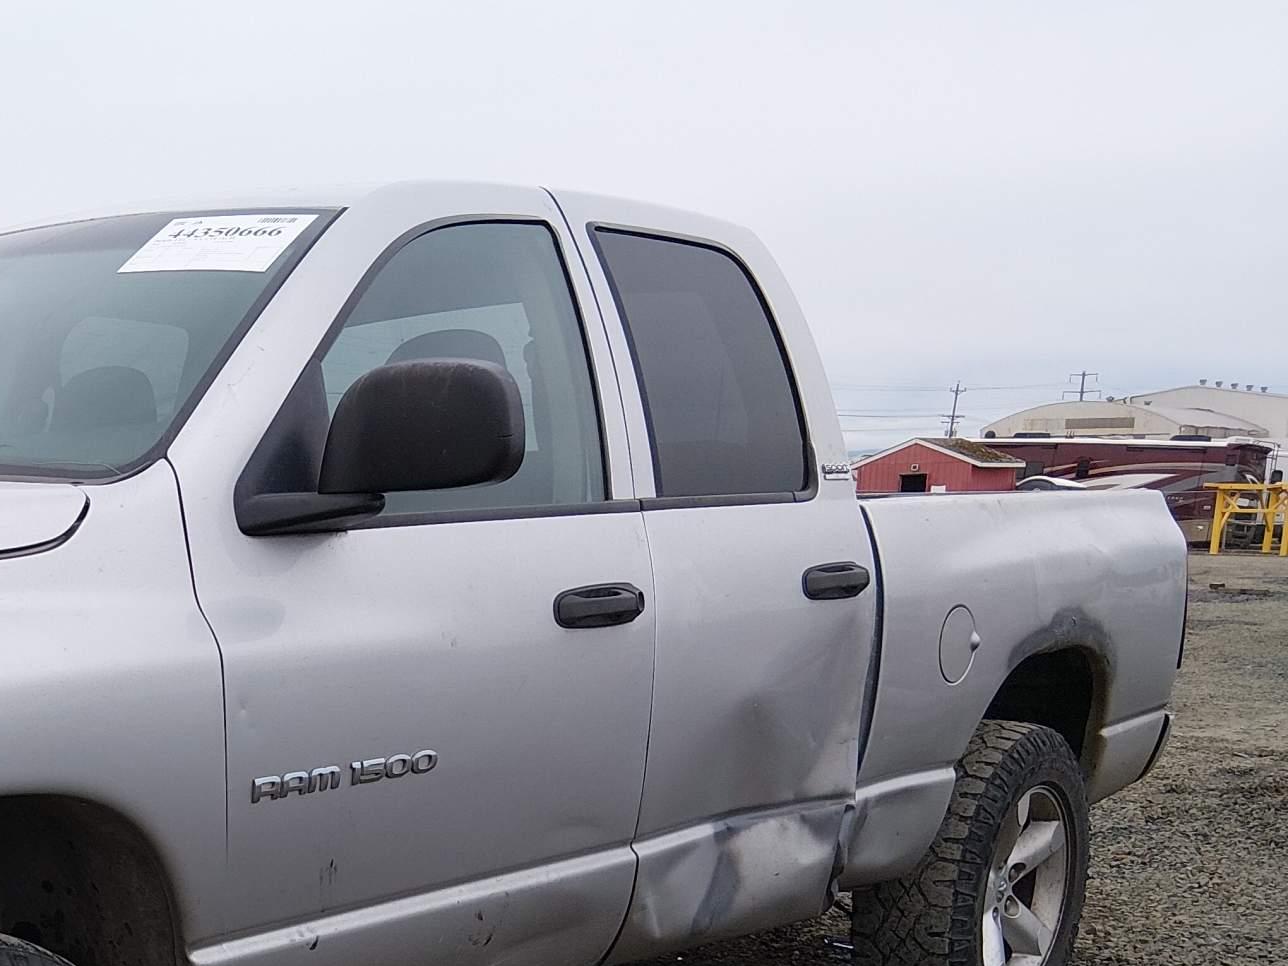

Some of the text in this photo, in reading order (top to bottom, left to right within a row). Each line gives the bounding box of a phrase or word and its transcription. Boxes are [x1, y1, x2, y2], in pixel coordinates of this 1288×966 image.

[168, 226, 284, 239] 44350666
[250, 749, 438, 804] RAM 1500
